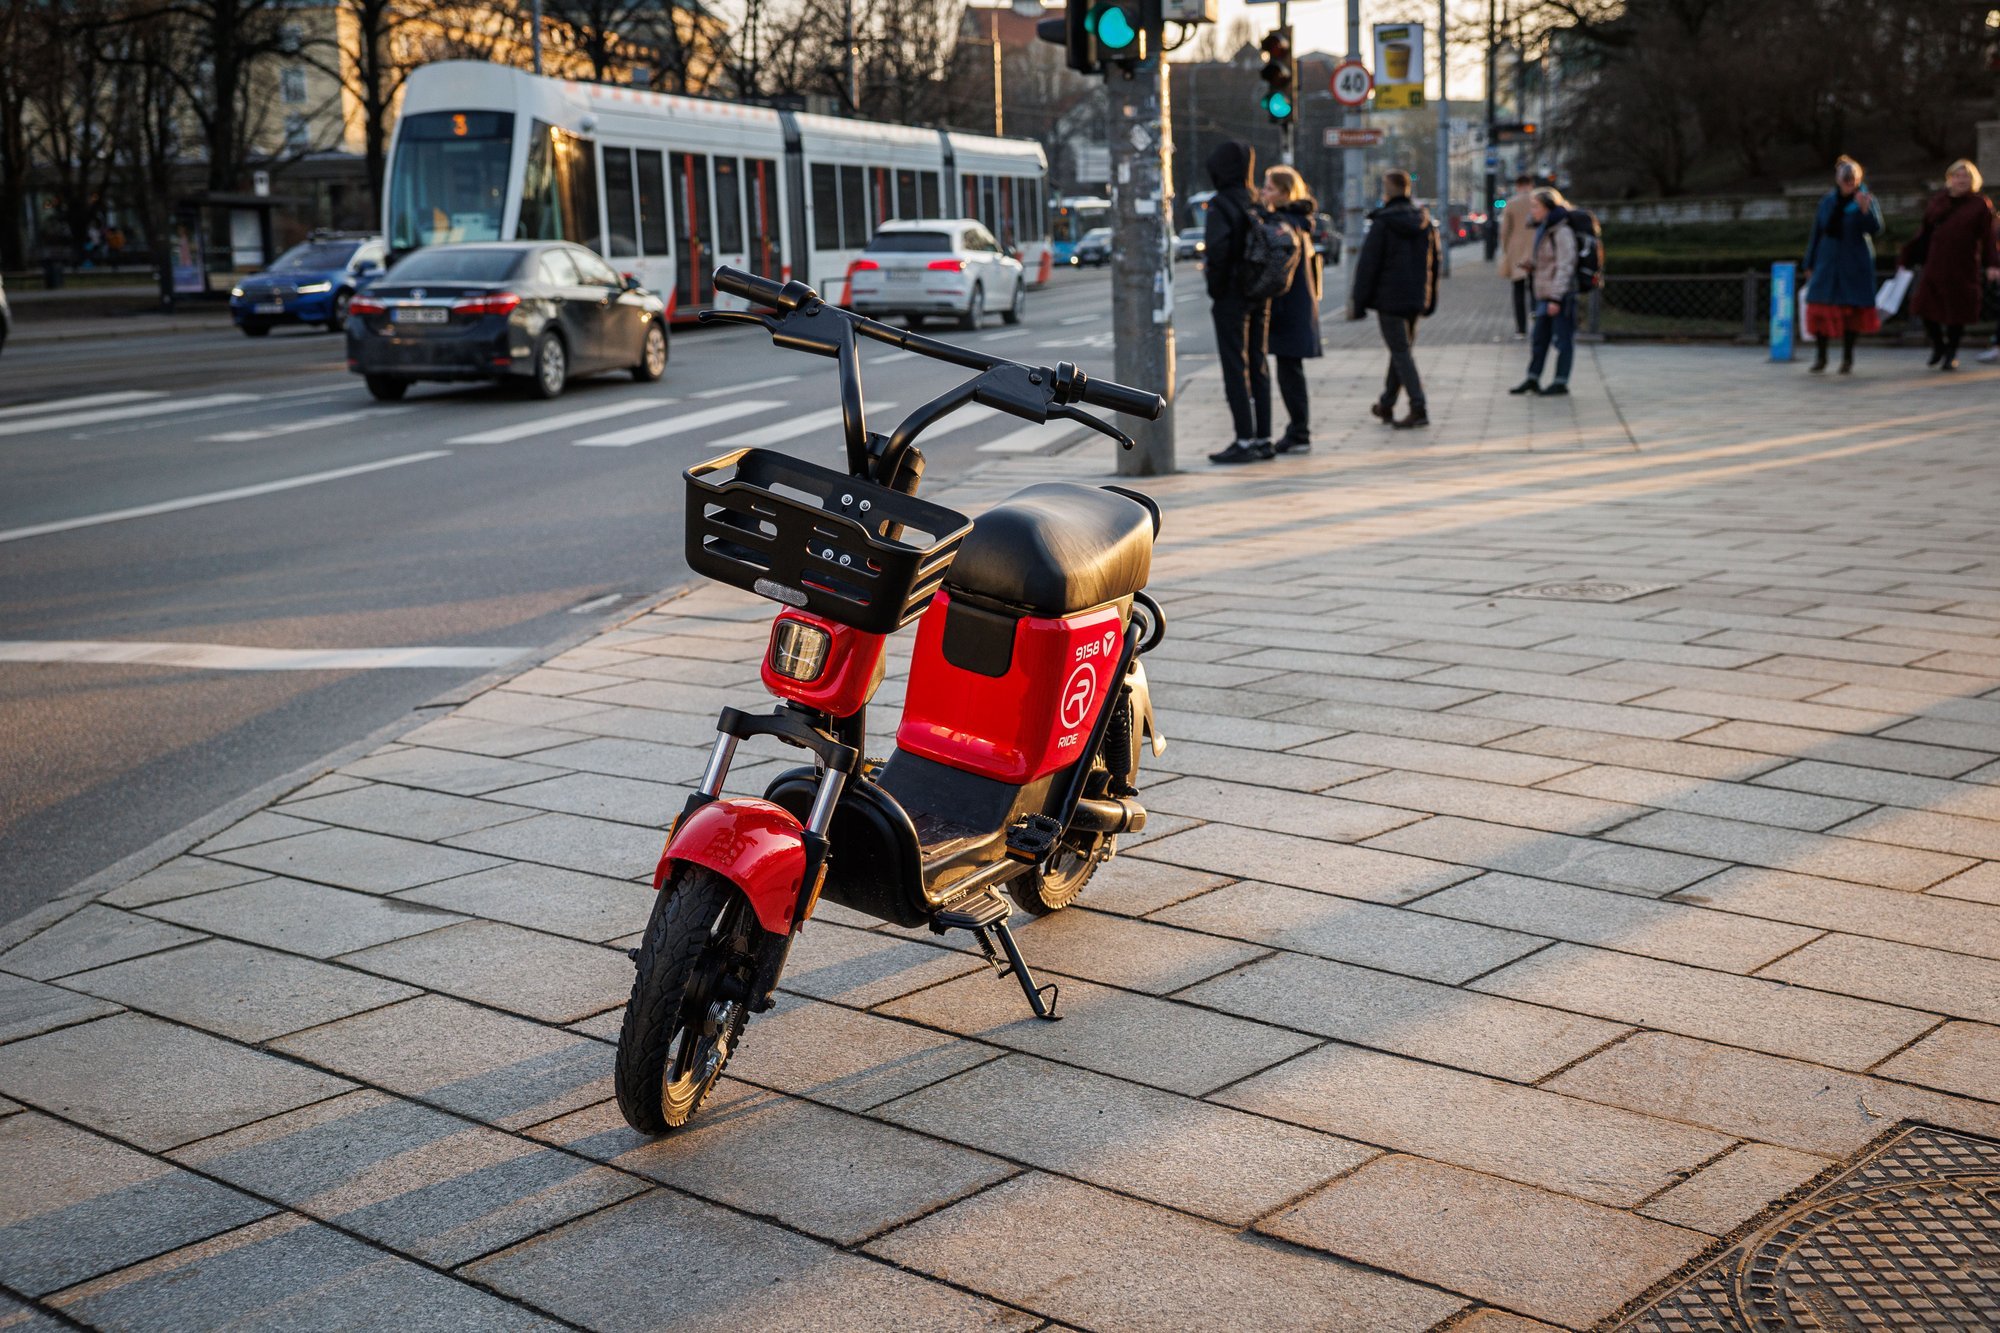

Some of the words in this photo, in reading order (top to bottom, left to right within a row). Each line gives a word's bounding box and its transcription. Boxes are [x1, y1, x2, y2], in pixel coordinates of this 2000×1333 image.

[1341, 72, 1365, 94] 40
[453, 113, 467, 136] 3
[1075, 640, 1100, 662] 9158
[1057, 733, 1078, 748] RIDE
